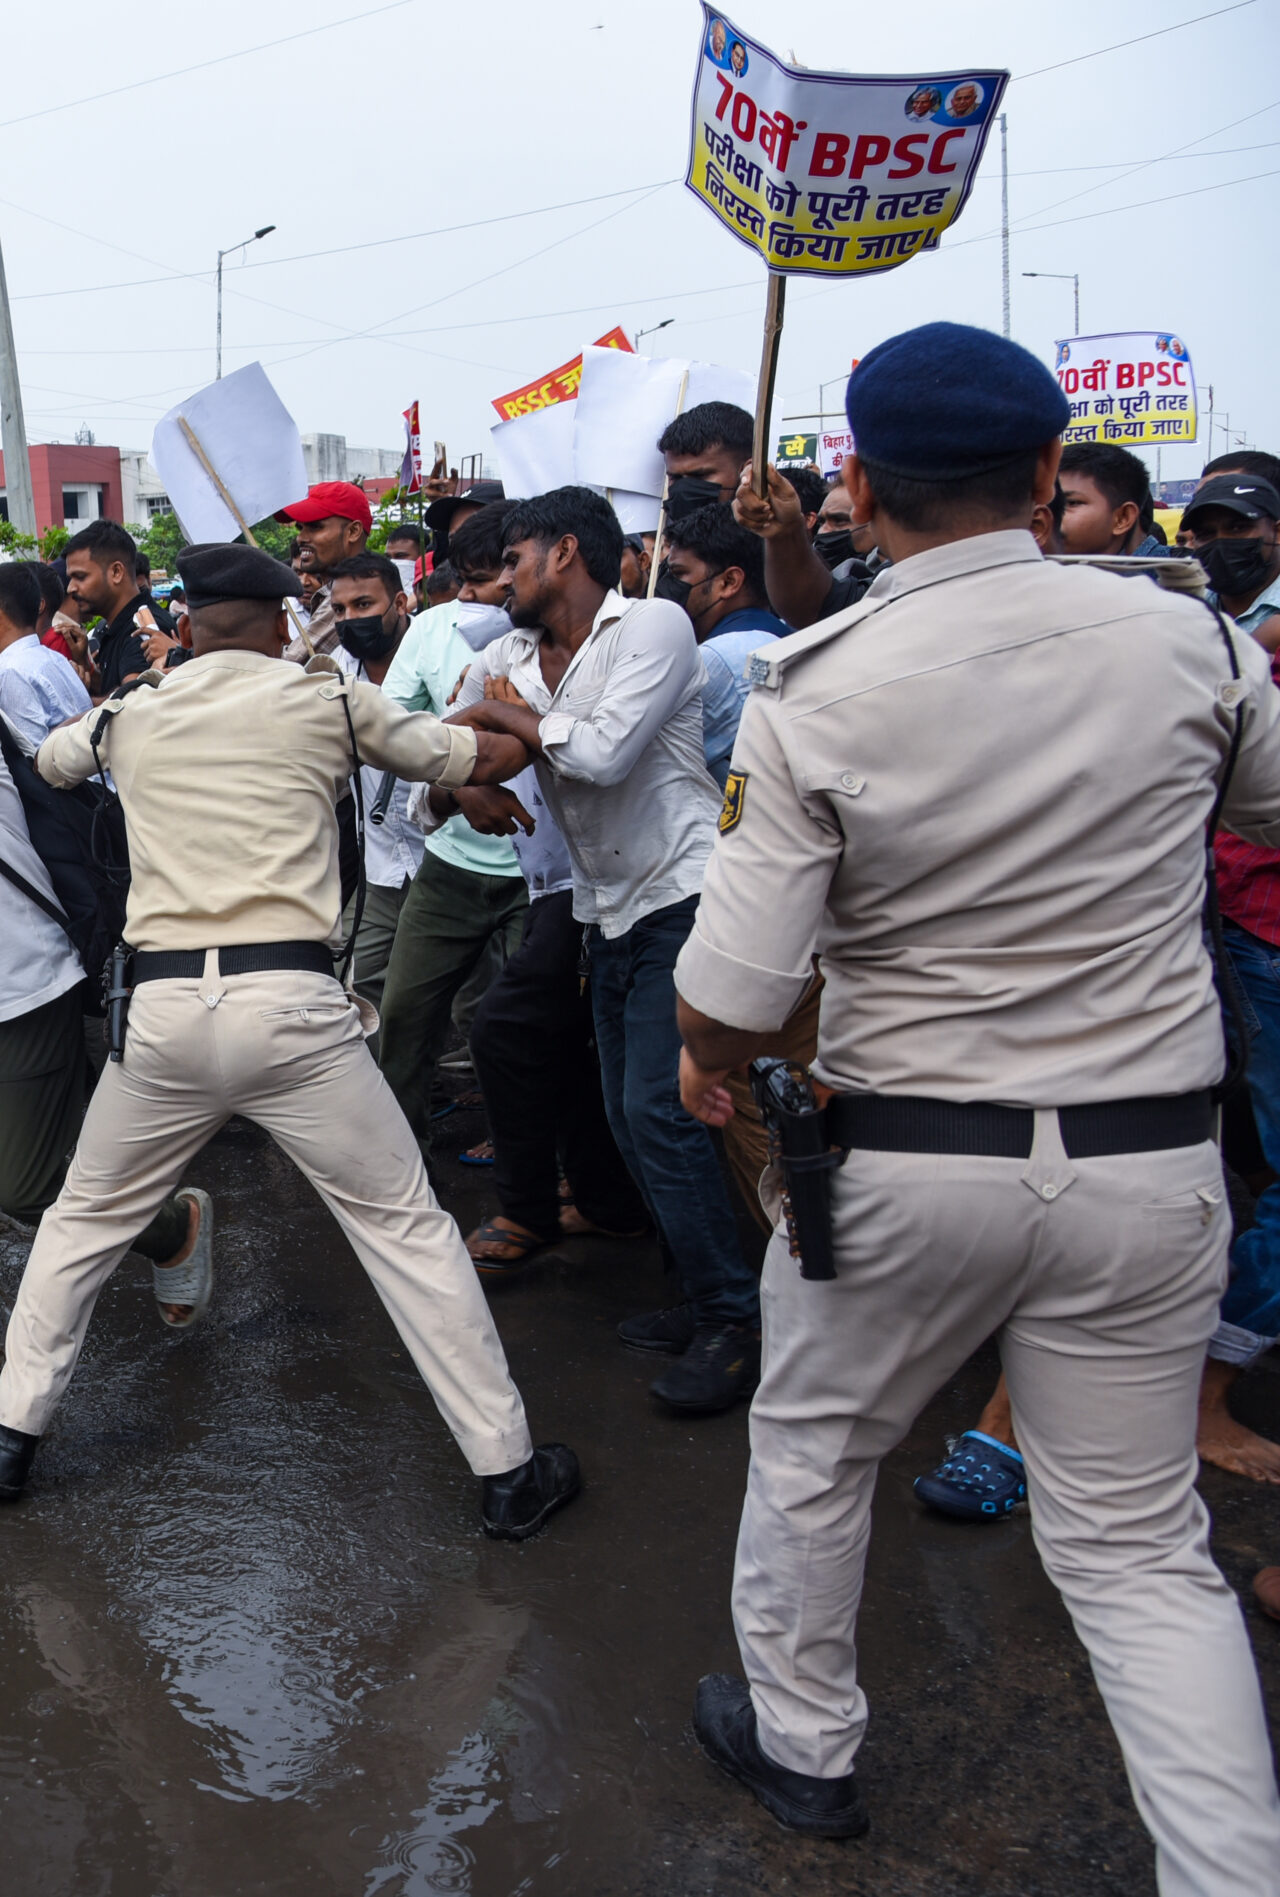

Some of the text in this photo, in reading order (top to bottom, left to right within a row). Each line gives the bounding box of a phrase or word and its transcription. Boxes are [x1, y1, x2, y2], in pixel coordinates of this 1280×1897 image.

[714, 71, 966, 180] 70वीं BPSC
[704, 121, 951, 231] परीक्षा को पूरी तरह
[705, 160, 767, 241] निरस्त
[769, 223, 850, 263] किया
[1116, 361, 1187, 390] BPSC
[1094, 393, 1115, 415] को
[1120, 391, 1151, 419] पूरी
[1155, 394, 1189, 412] तरह
[823, 435, 845, 450] बिहार
[1103, 419, 1146, 440] किया
